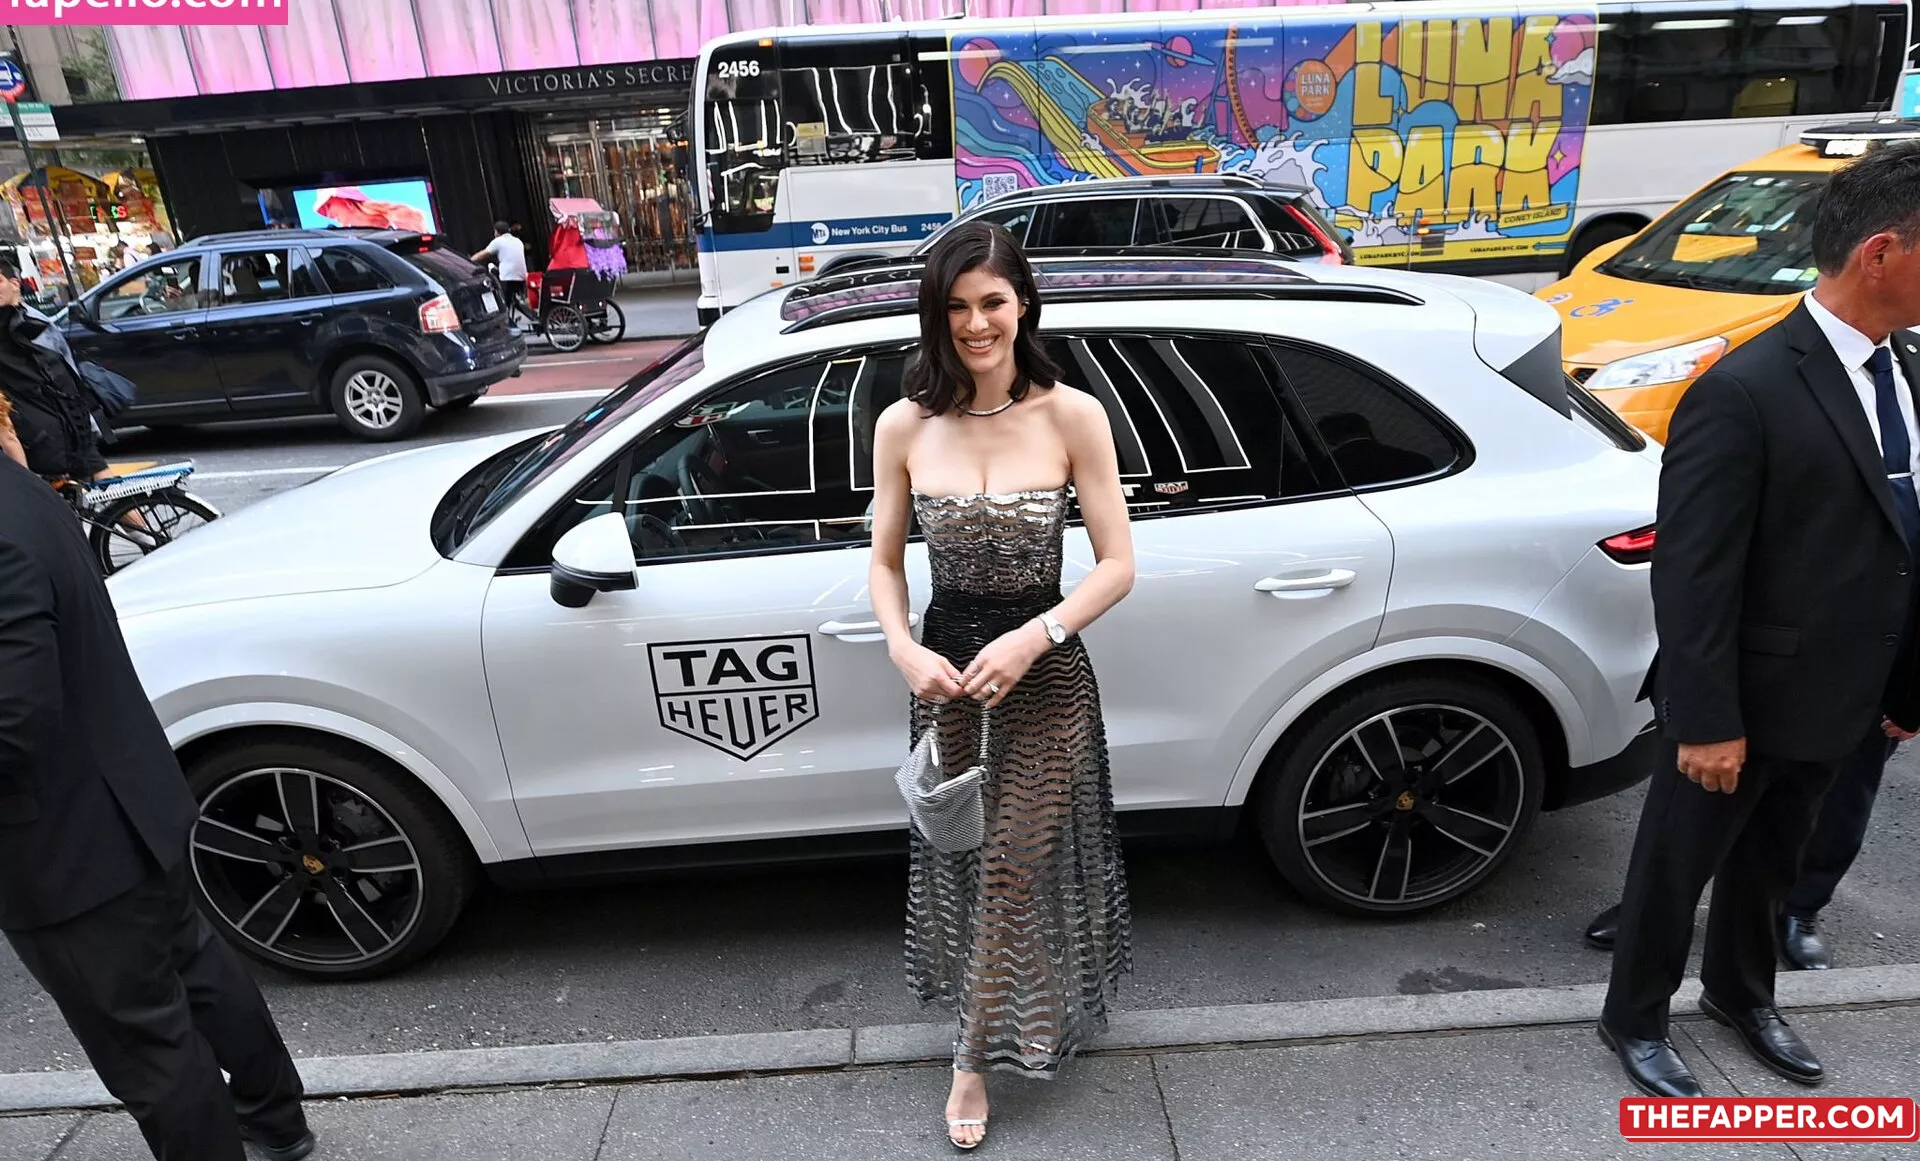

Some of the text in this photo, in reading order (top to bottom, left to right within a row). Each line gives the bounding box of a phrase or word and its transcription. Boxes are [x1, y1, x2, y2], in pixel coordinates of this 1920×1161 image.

[718, 60, 760, 78] 2456
[1301, 73, 1330, 85] LUNA
[1353, 16, 1563, 125] LUNA
[487, 69, 615, 95] VICTORIA'S
[1301, 84, 1330, 96] PARK
[1346, 120, 1562, 226] PARK
[1504, 207, 1562, 223] CONEY ISLAND
[831, 224, 908, 237] New York City Bus
[662, 644, 799, 687] TAG
[667, 693, 808, 750] HEUER
